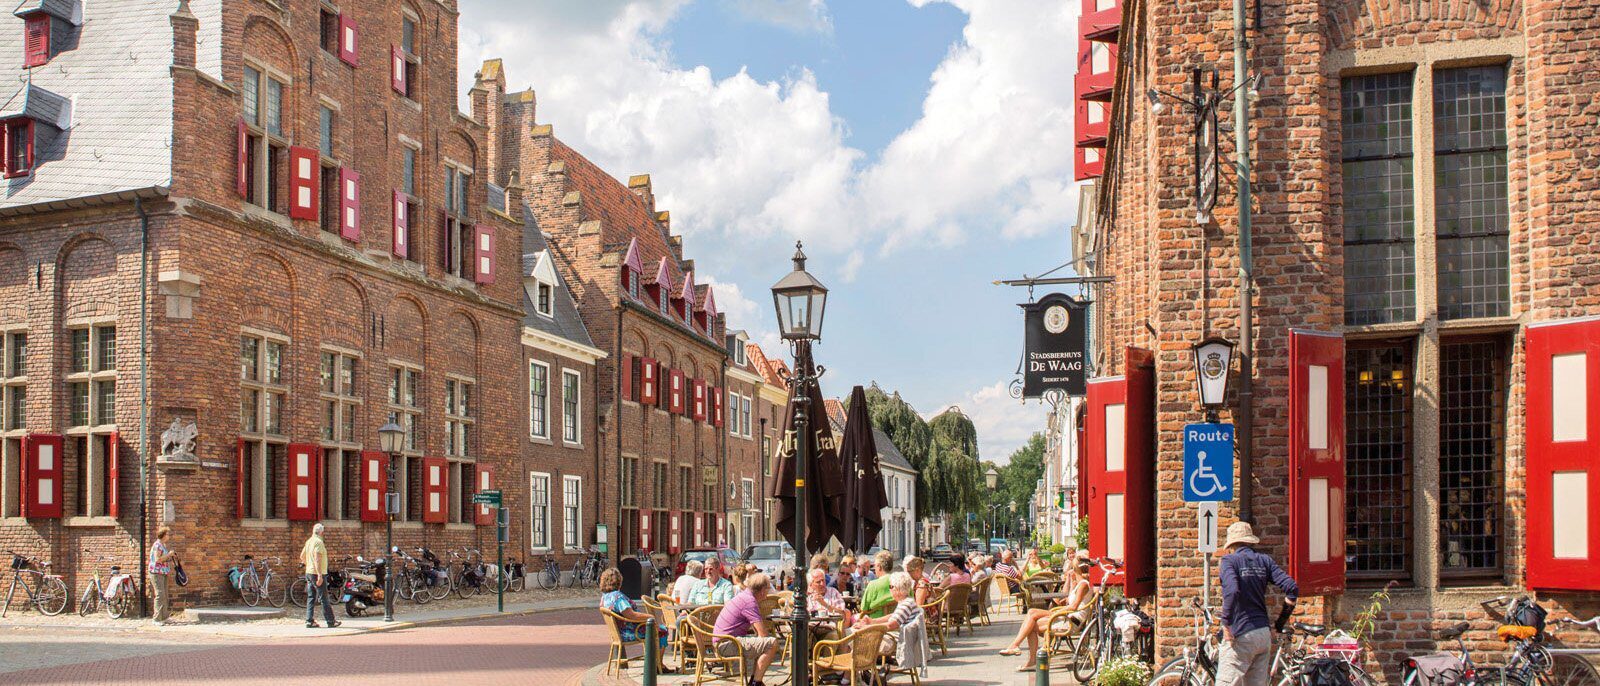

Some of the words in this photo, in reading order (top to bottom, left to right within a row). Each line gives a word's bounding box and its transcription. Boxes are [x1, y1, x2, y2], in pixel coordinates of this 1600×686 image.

[1030, 351, 1082, 360] STADSBIERHUYS
[1030, 361, 1046, 372] DE
[1048, 360, 1082, 371] WAAG
[1189, 430, 1229, 442] Route
